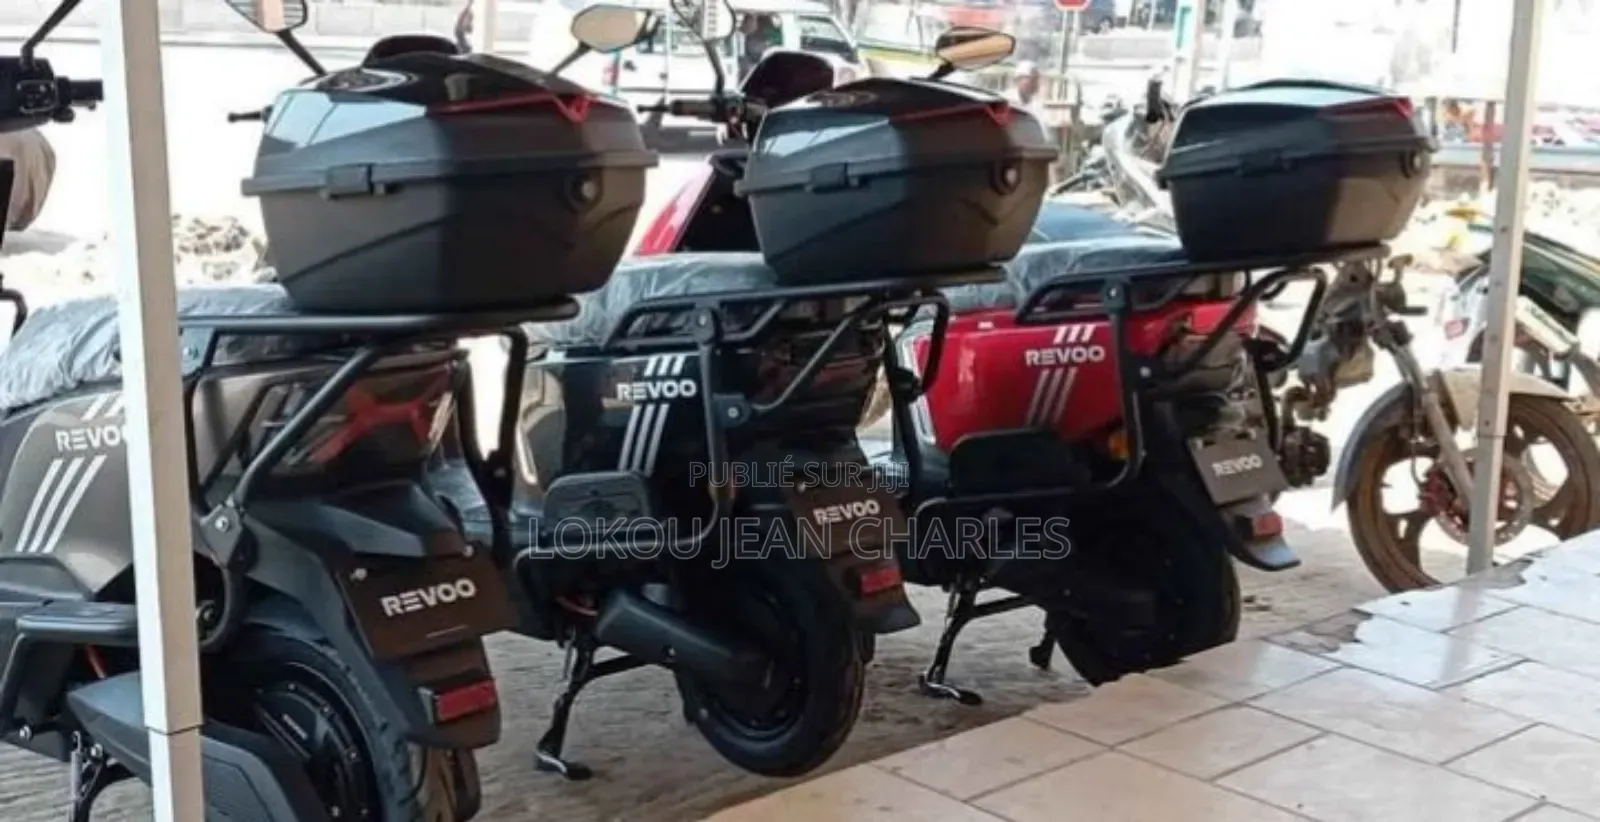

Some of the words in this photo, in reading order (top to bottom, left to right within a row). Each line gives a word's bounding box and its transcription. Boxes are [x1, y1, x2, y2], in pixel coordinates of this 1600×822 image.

[1025, 345, 1105, 366] REVOO
[616, 378, 697, 401] REVOO
[55, 424, 127, 452] REVO
[1211, 455, 1263, 477] REVOO
[813, 499, 880, 526] REVOO
[380, 577, 477, 617] REVOO
